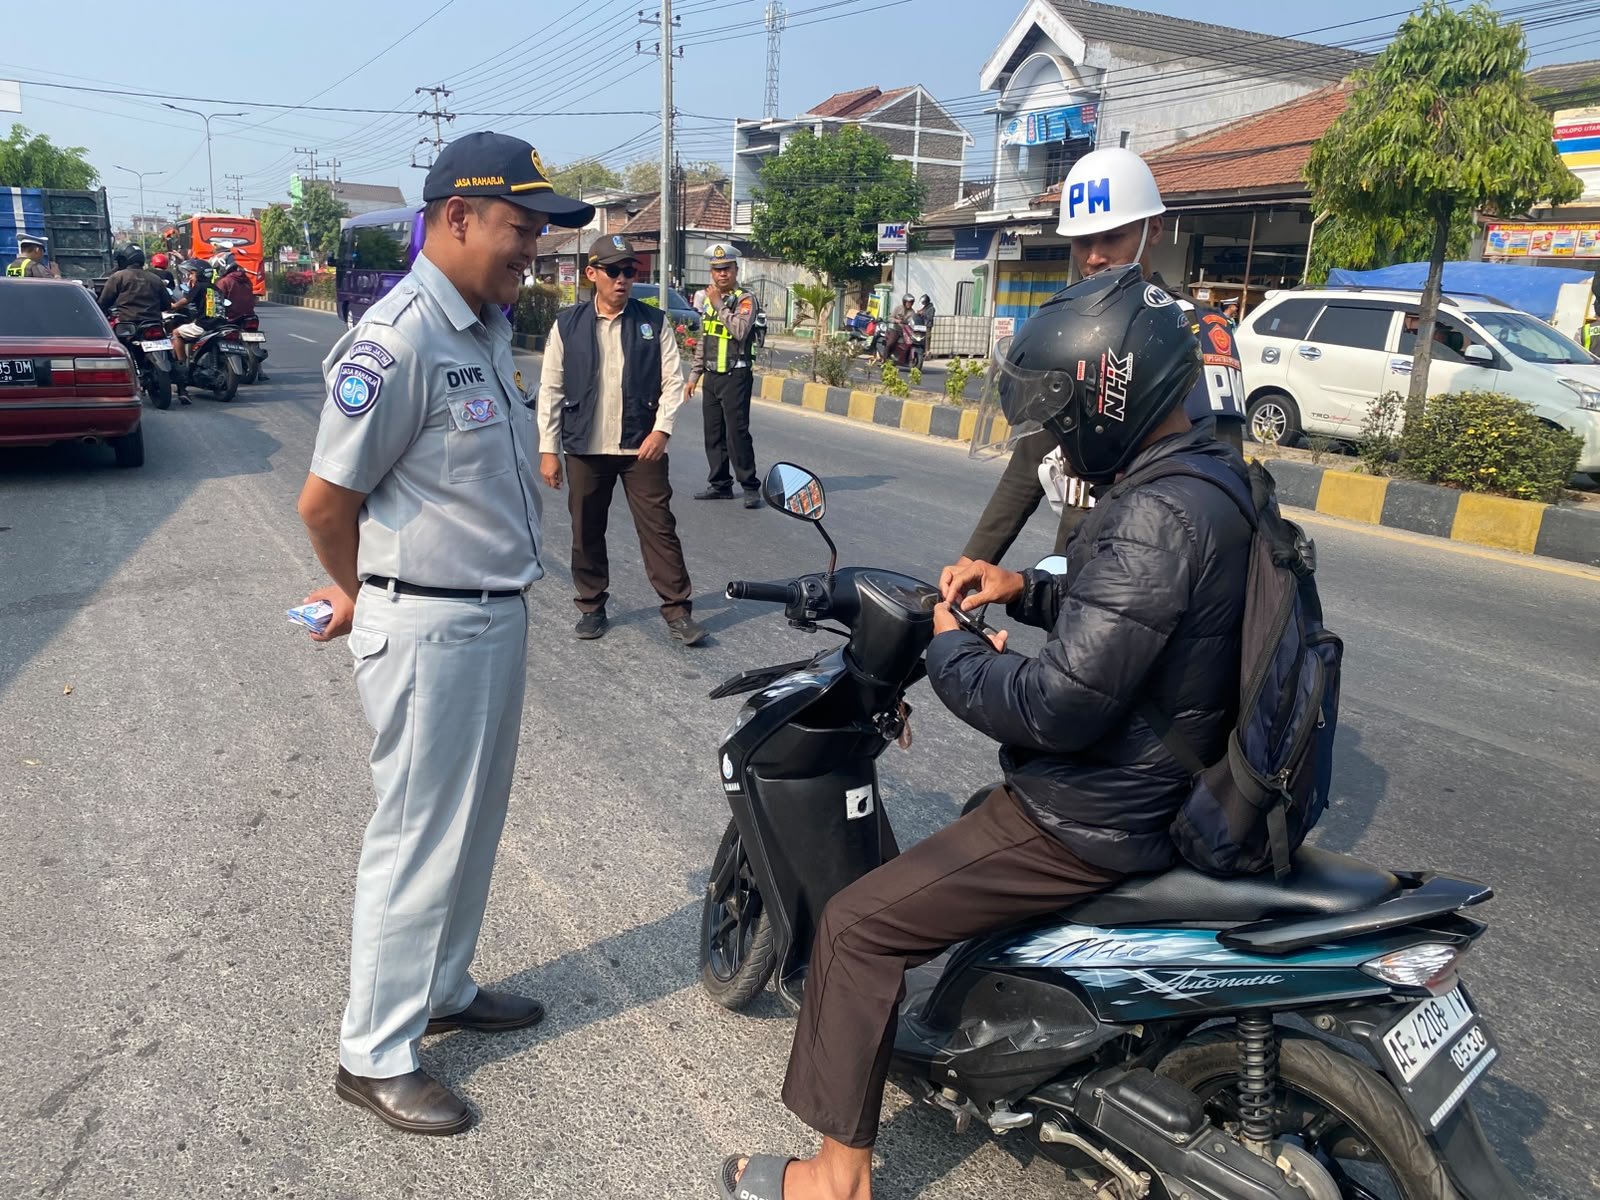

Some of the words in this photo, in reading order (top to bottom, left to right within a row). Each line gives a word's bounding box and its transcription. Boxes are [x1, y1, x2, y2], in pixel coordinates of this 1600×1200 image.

[1556, 126, 1583, 135] DOLOPO
[454, 178, 471, 188] JASA
[471, 176, 505, 187] RAHARJA
[1069, 178, 1110, 218] PM
[882, 225, 905, 239] JNE
[15, 361, 32, 373] DM
[1104, 347, 1130, 422] NHK
[1142, 968, 1285, 994] Automatic
[1388, 1030, 1418, 1074] AE
[1411, 1001, 1449, 1051] 4208
